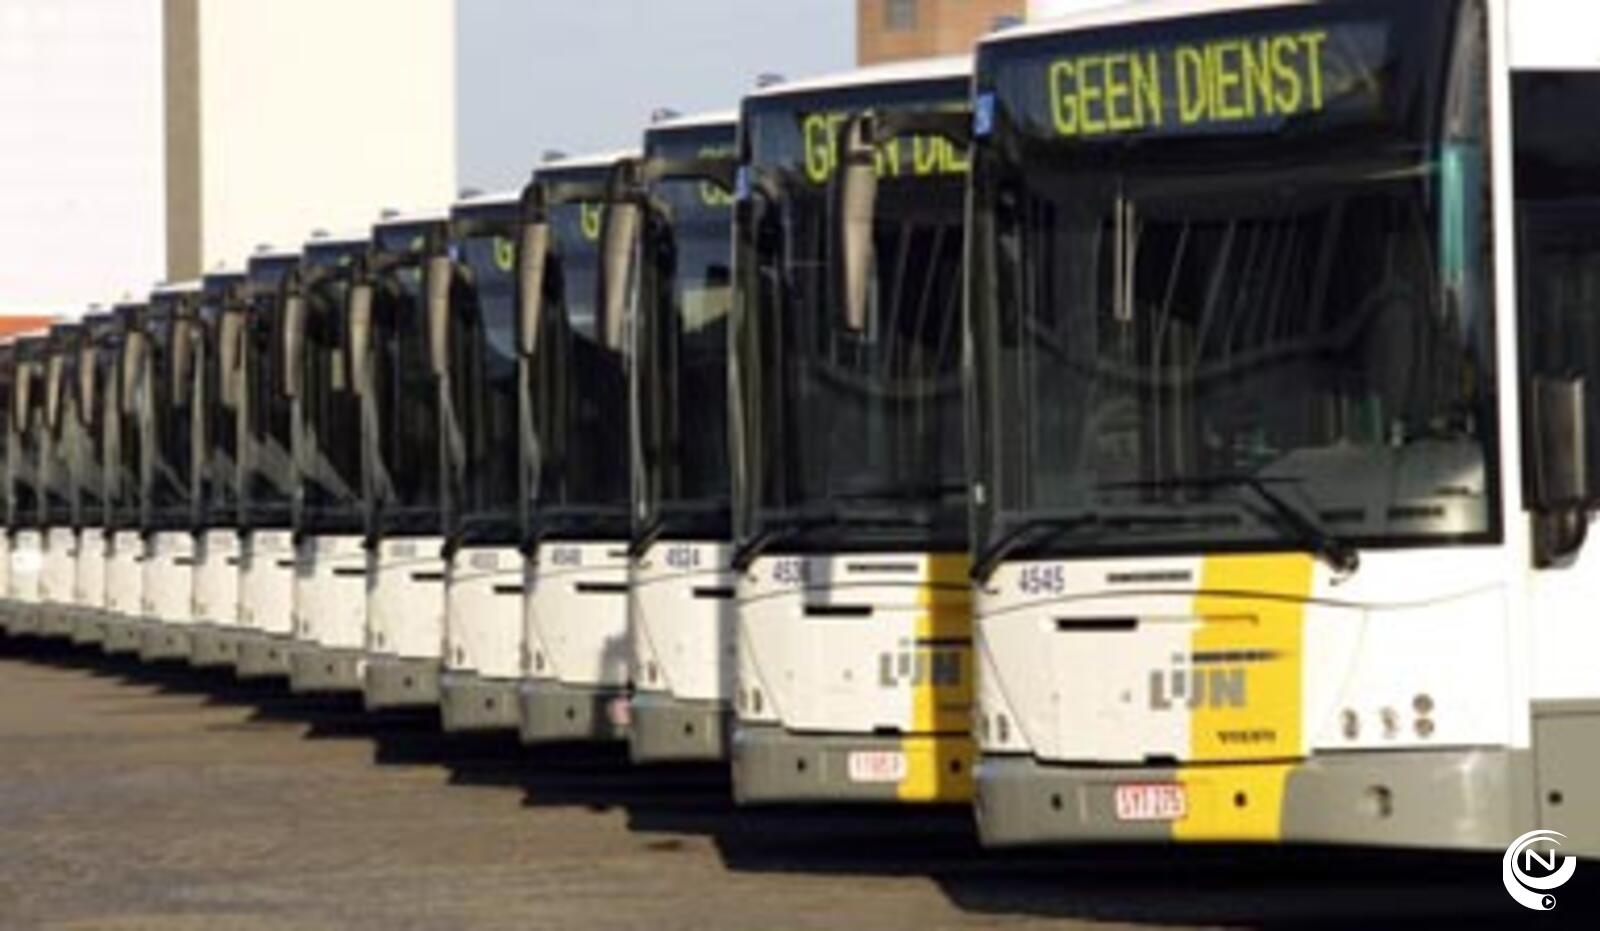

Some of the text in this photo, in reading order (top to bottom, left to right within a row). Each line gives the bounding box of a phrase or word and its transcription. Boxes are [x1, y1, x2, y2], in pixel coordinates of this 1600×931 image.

[1049, 31, 1327, 135] GEEN DIENST
[1018, 565, 1065, 594] 4545
